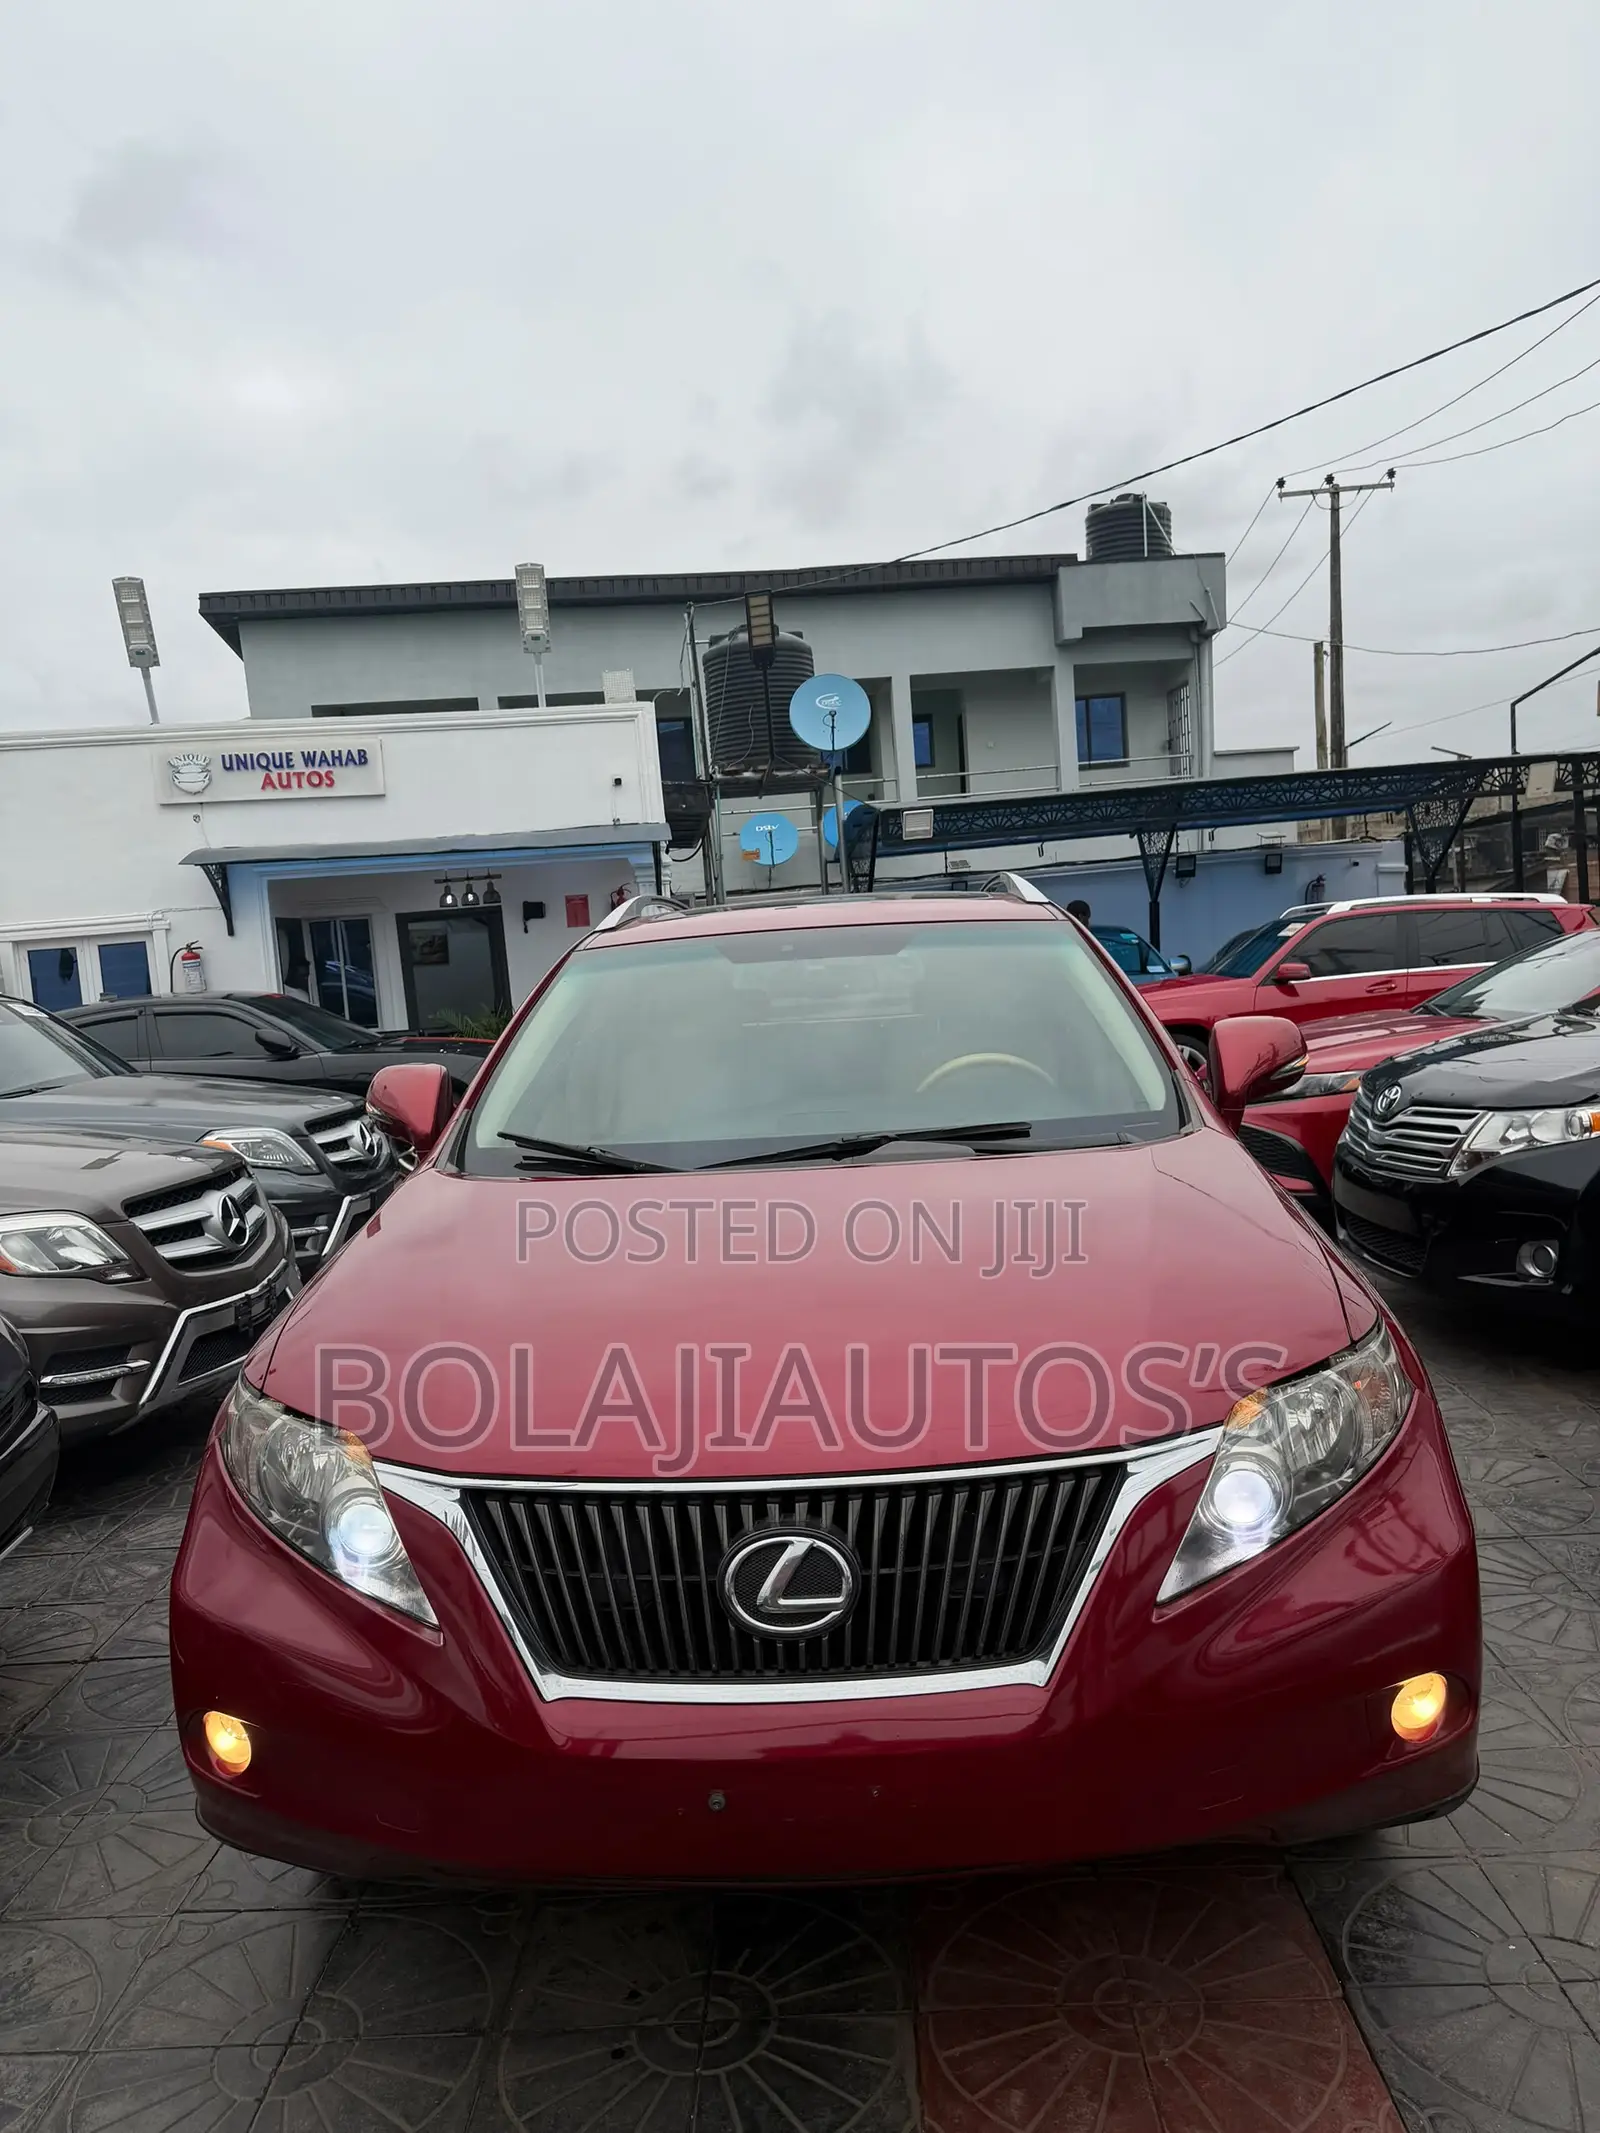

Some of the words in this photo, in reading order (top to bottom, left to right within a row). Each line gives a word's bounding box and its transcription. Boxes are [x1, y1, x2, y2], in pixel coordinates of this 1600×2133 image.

[221, 751, 294, 772] UNIQUE
[301, 749, 368, 769] WAHAB
[261, 770, 335, 791] AUTOS
